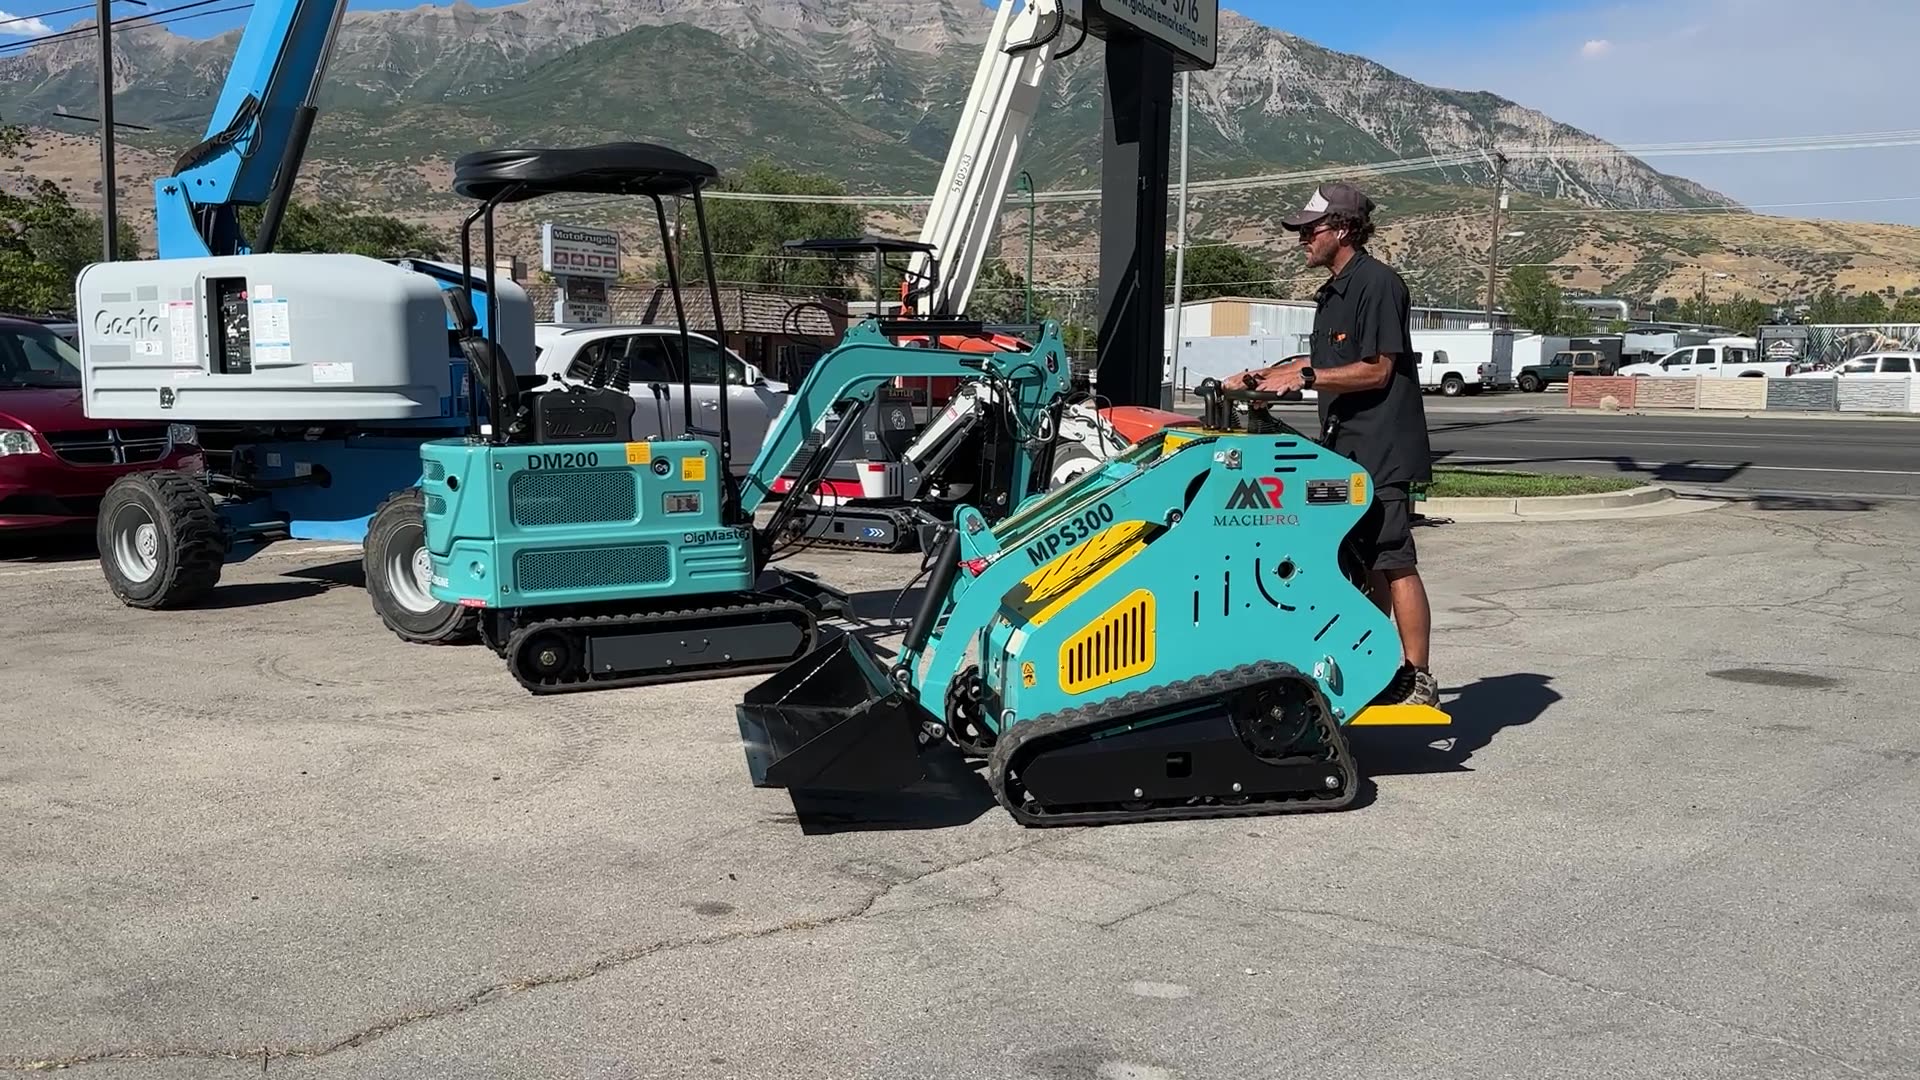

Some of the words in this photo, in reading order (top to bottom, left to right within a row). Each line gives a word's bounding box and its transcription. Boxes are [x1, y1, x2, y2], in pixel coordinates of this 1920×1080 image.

[553, 229, 617, 246] MotoFrugals
[528, 452, 599, 470] DM200
[1213, 514, 1299, 527] MACHPRO
[1026, 503, 1114, 567] MPS300
